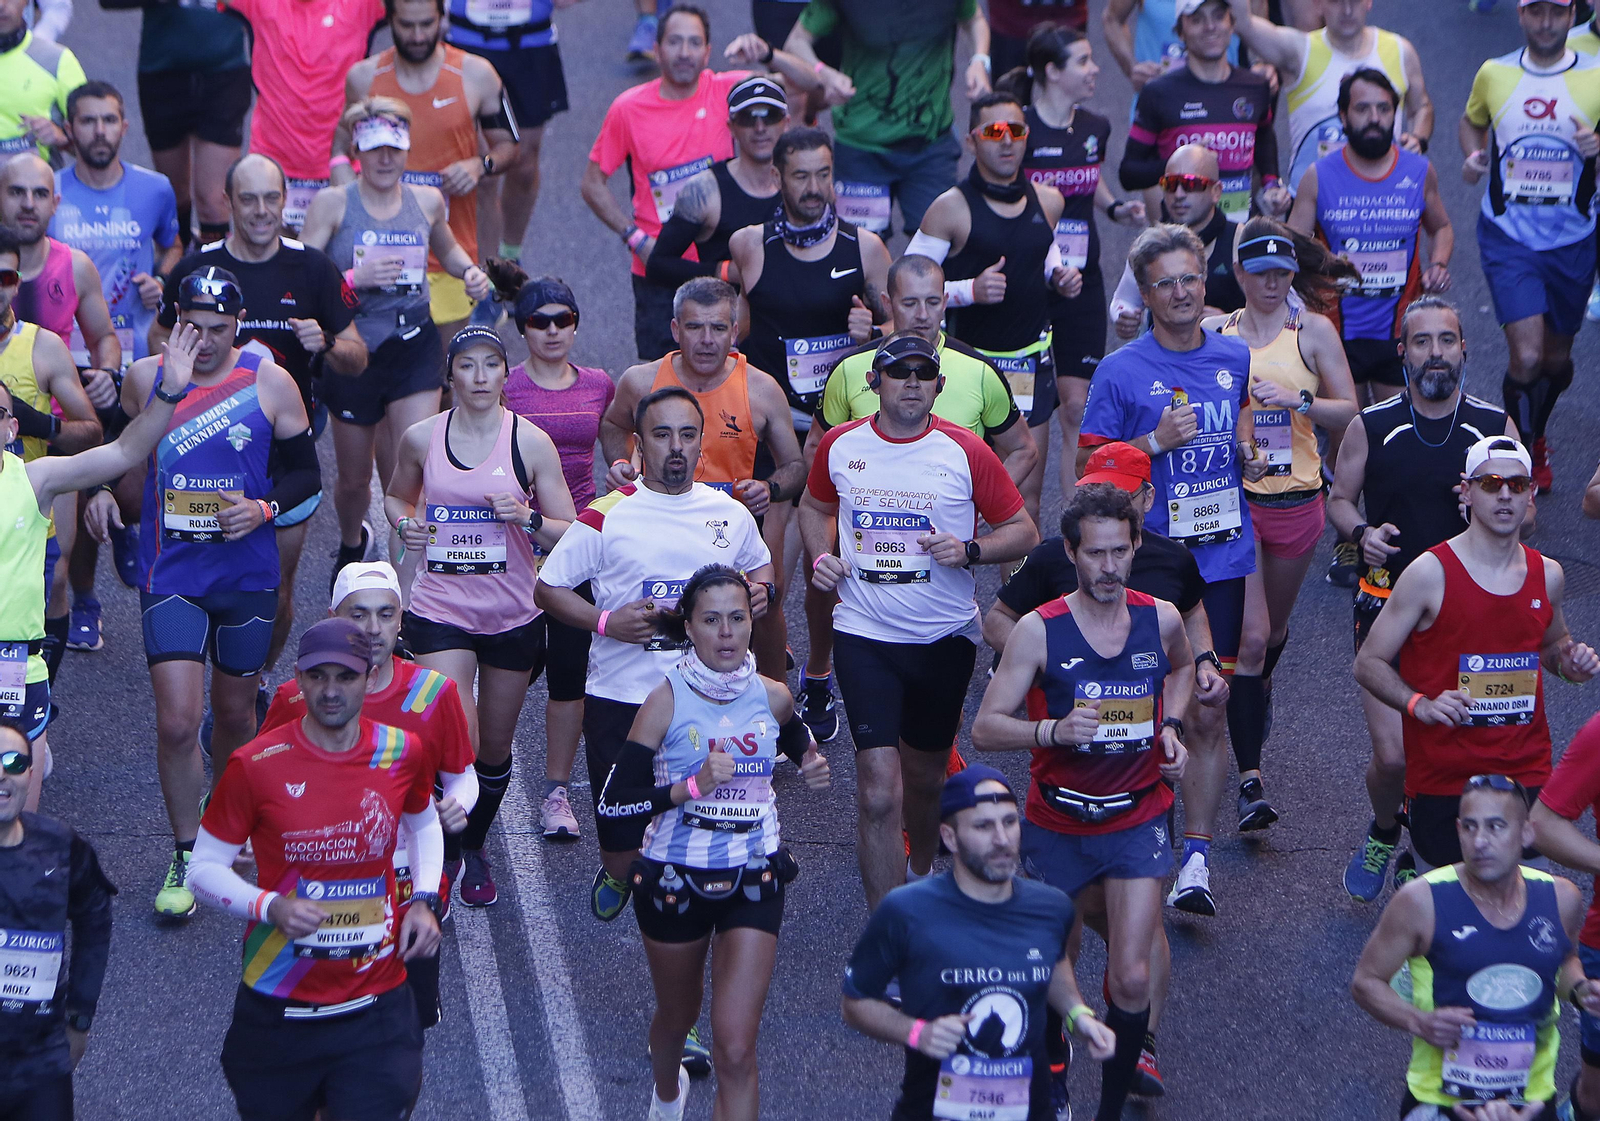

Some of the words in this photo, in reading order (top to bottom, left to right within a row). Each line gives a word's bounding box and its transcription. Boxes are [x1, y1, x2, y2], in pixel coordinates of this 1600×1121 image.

[63, 220, 141, 239] RUNNING
[378, 233, 417, 245] ZURICH
[1361, 239, 1400, 251] ZURICH
[811, 336, 851, 352] ZURICH
[813, 361, 835, 375] 806
[168, 426, 195, 444] C.A.
[196, 397, 240, 429] JIMENA
[1254, 414, 1282, 425] RICH
[175, 415, 232, 456] RUNNERS
[848, 458, 866, 472] edp
[1166, 444, 1231, 476] 1873
[189, 478, 234, 489] ZURICH
[1191, 477, 1229, 494] ZURICH
[850, 487, 865, 495] EDP
[866, 488, 894, 497] MEDIO
[895, 491, 938, 501] MARATÓN
[188, 502, 220, 514] 5873
[854, 496, 871, 506] DE
[878, 498, 933, 511] SEVILLA
[452, 510, 496, 520] ZURICH
[1193, 503, 1220, 518] 8863
[189, 519, 219, 528] ROJAS
[875, 516, 920, 527] ZURICH
[1193, 520, 1220, 532] ÓSCAR
[451, 534, 483, 545] 8416
[874, 542, 906, 553] 6963
[447, 551, 486, 560] PERALES
[876, 559, 903, 568] MADA
[1486, 657, 1529, 669] ZURICH
[1104, 683, 1148, 696] ZURICH
[1485, 683, 1515, 696] 5724
[1102, 710, 1134, 722] 4504
[1104, 728, 1128, 738] JUAN
[734, 763, 763, 773] RICH
[714, 788, 747, 801] 8372
[597, 797, 653, 817] balance
[694, 805, 718, 815] PATO
[720, 806, 761, 818] ABALLAY
[284, 837, 357, 852] ASOCIACIÓN
[285, 852, 322, 863] MARCO
[325, 850, 356, 861] LUNA
[327, 883, 376, 897] ZURICH
[325, 912, 360, 926] 4706
[9, 934, 55, 950] ZURICH
[317, 931, 365, 943] WITELEAY
[4, 964, 37, 979] 9621
[940, 967, 1003, 984] CERRO
[1008, 971, 1028, 982] DEL
[2, 984, 31, 996] MOEZ
[1477, 1026, 1526, 1041] ZURICH
[972, 1060, 1023, 1077] ZURICH
[969, 1088, 1005, 1105] 7546
